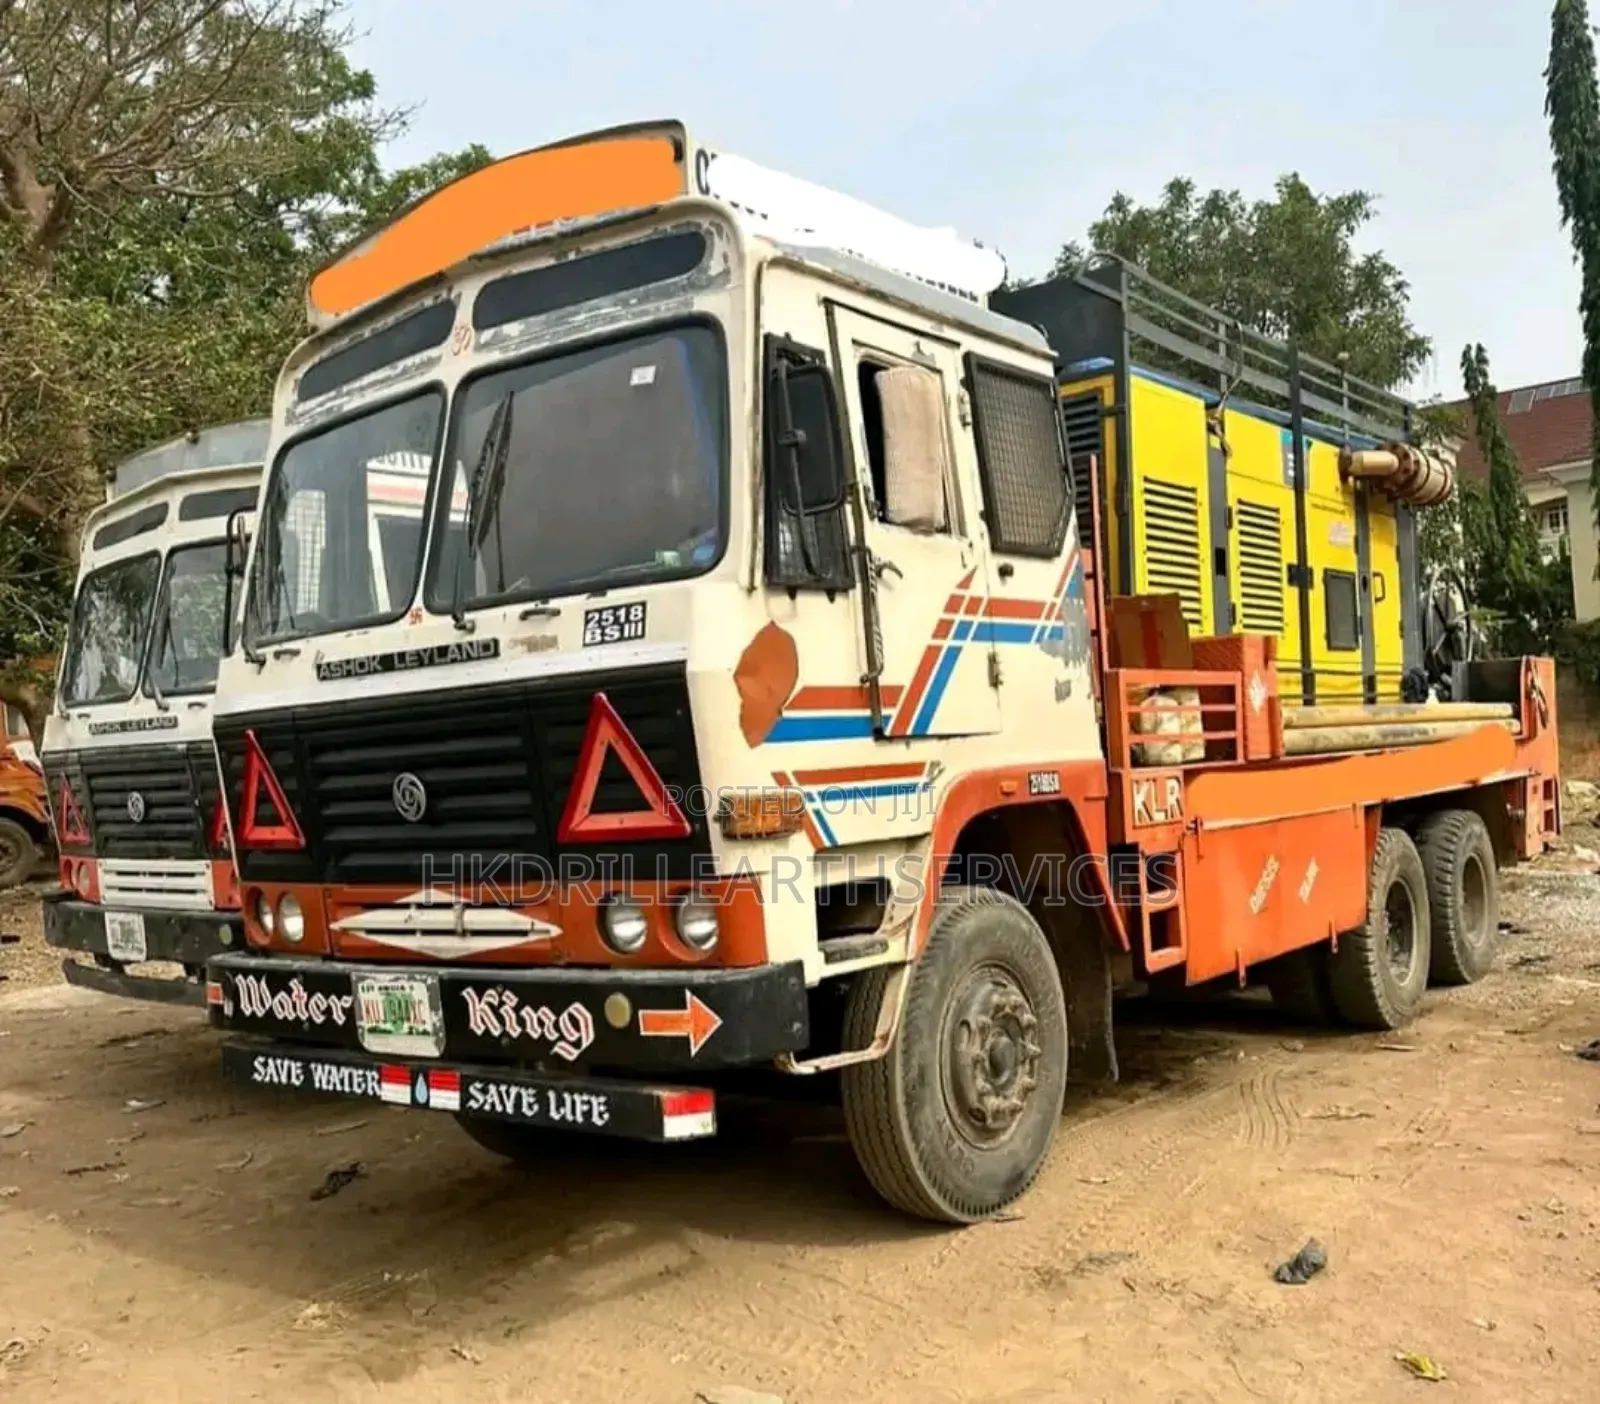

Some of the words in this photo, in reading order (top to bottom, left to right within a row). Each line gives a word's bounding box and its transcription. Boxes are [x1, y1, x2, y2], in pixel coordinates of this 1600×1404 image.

[586, 604, 644, 629] 2518
[318, 656, 381, 680] ASHOK
[394, 638, 496, 670] LEYLAND
[1132, 776, 1183, 825] KLR
[235, 973, 353, 1026] Water
[459, 986, 596, 1061] King
[252, 1055, 304, 1086] SAVE
[310, 1061, 382, 1096] WATER
[467, 1081, 541, 1117] SAVE
[548, 1089, 611, 1126] LIFE
